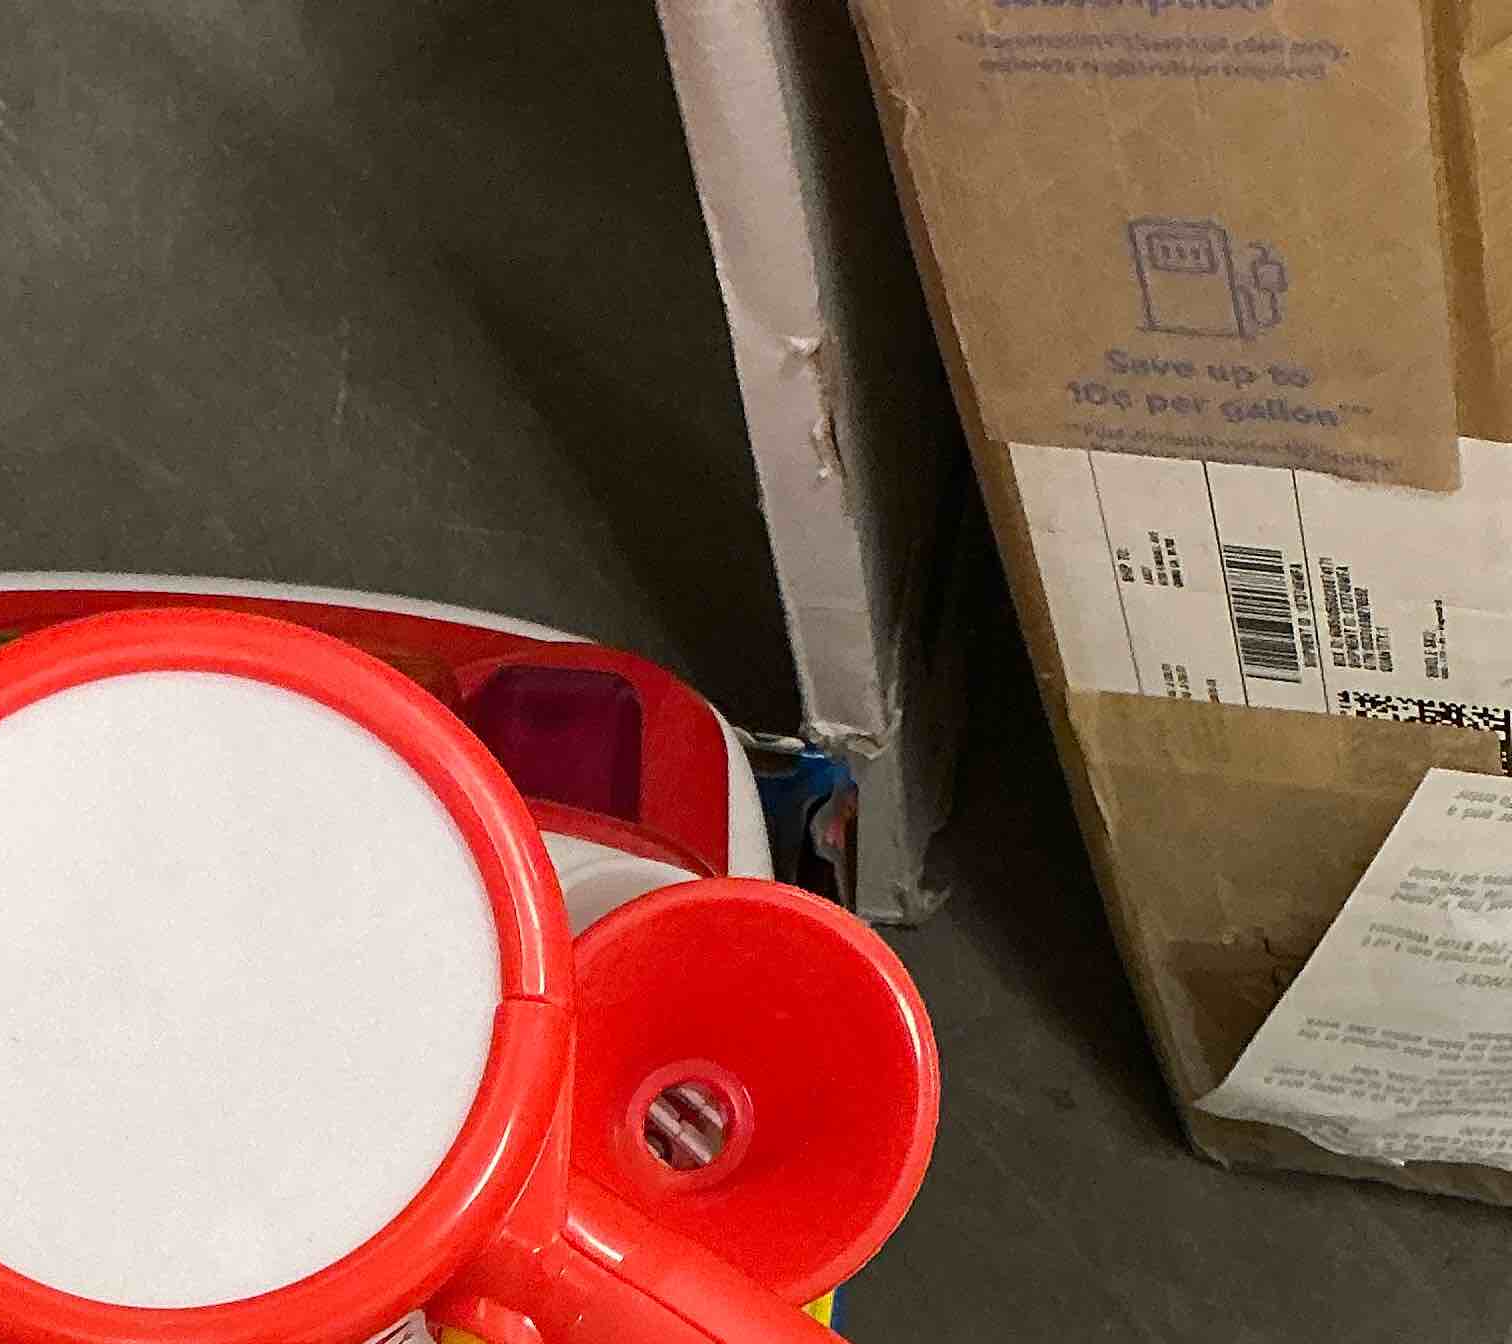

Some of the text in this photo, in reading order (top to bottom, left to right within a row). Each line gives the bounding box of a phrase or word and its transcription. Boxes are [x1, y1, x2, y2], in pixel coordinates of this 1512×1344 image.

[1105, 348, 1312, 390] Save up to
[1145, 392, 1209, 416] per
